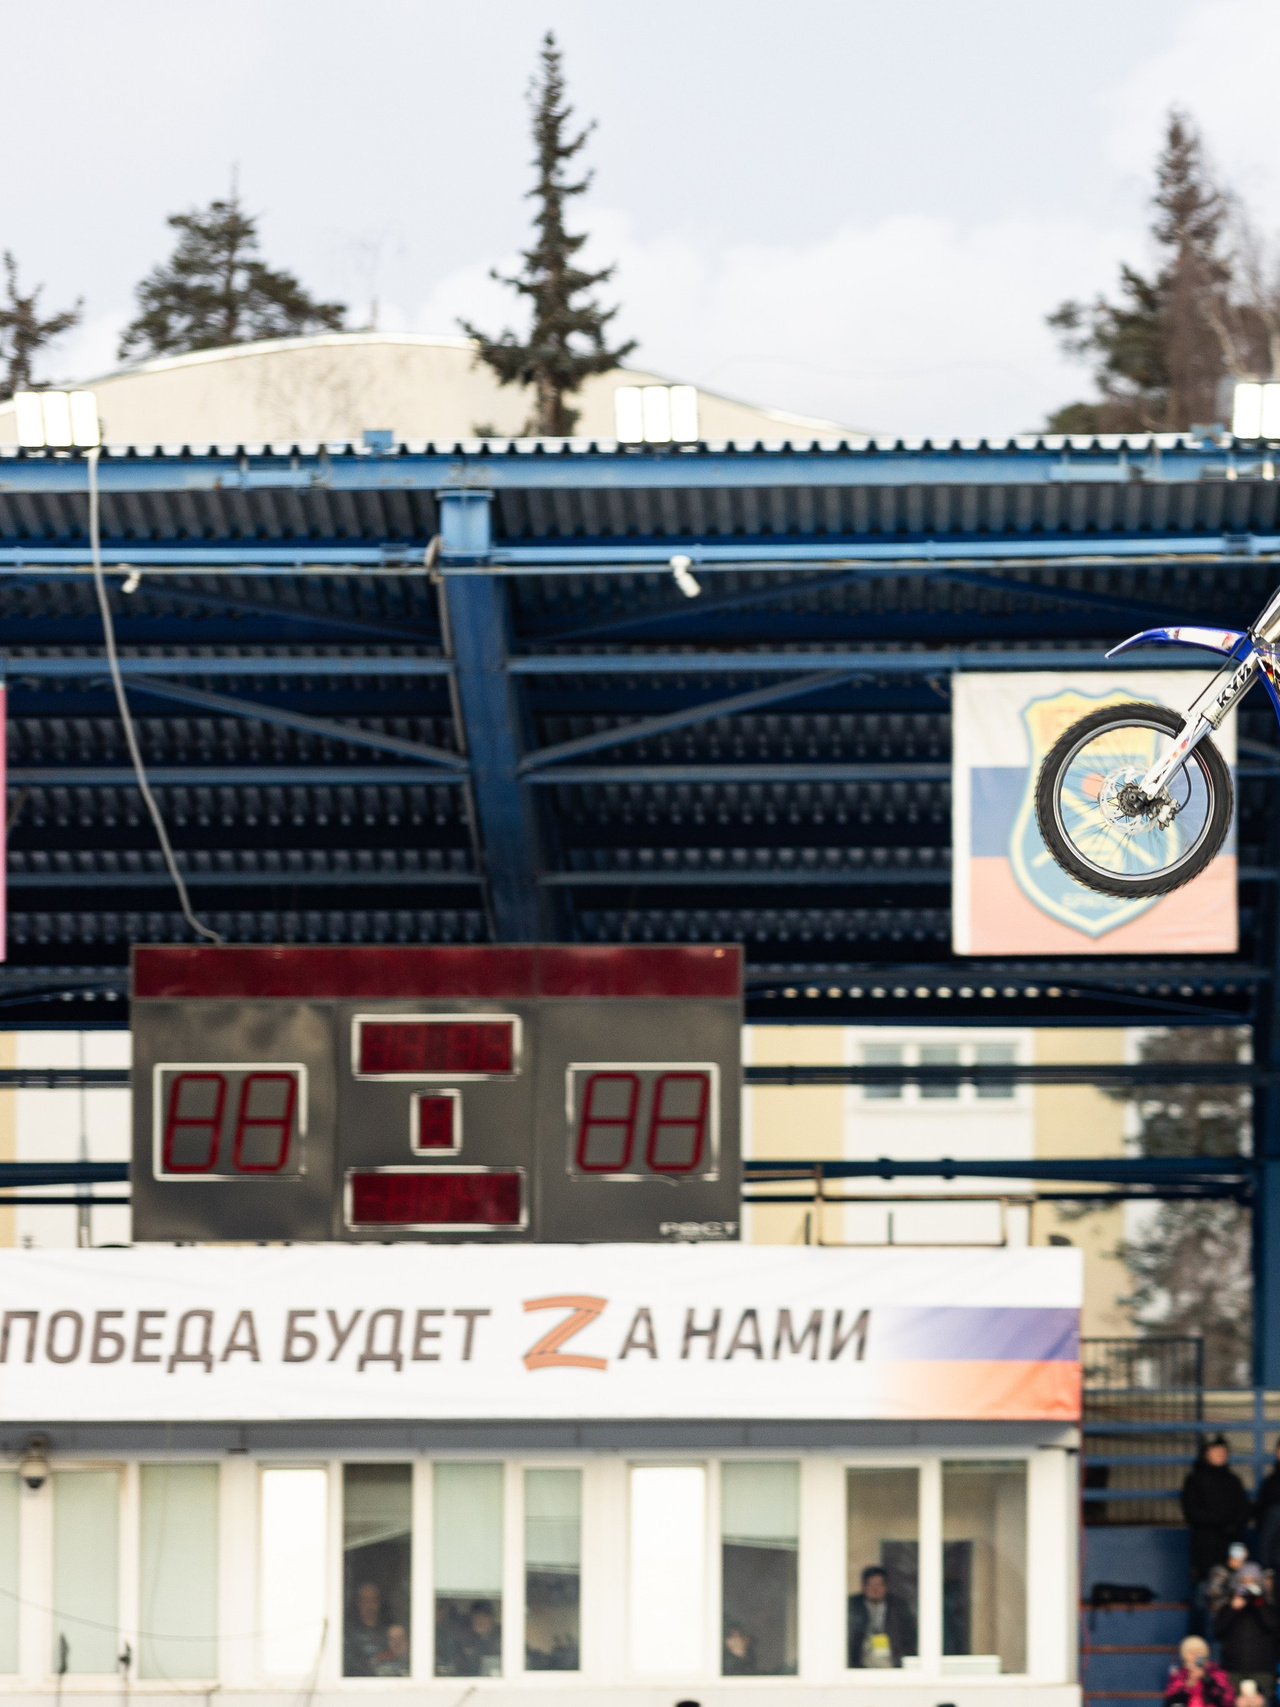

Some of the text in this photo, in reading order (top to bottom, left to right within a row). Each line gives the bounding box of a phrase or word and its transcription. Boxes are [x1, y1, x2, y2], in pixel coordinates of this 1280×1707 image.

[0, 1309, 261, 1373] ПОБЕДА
[282, 1308, 491, 1372] БУДЕТ
[680, 1307, 872, 1361] НАМИ
